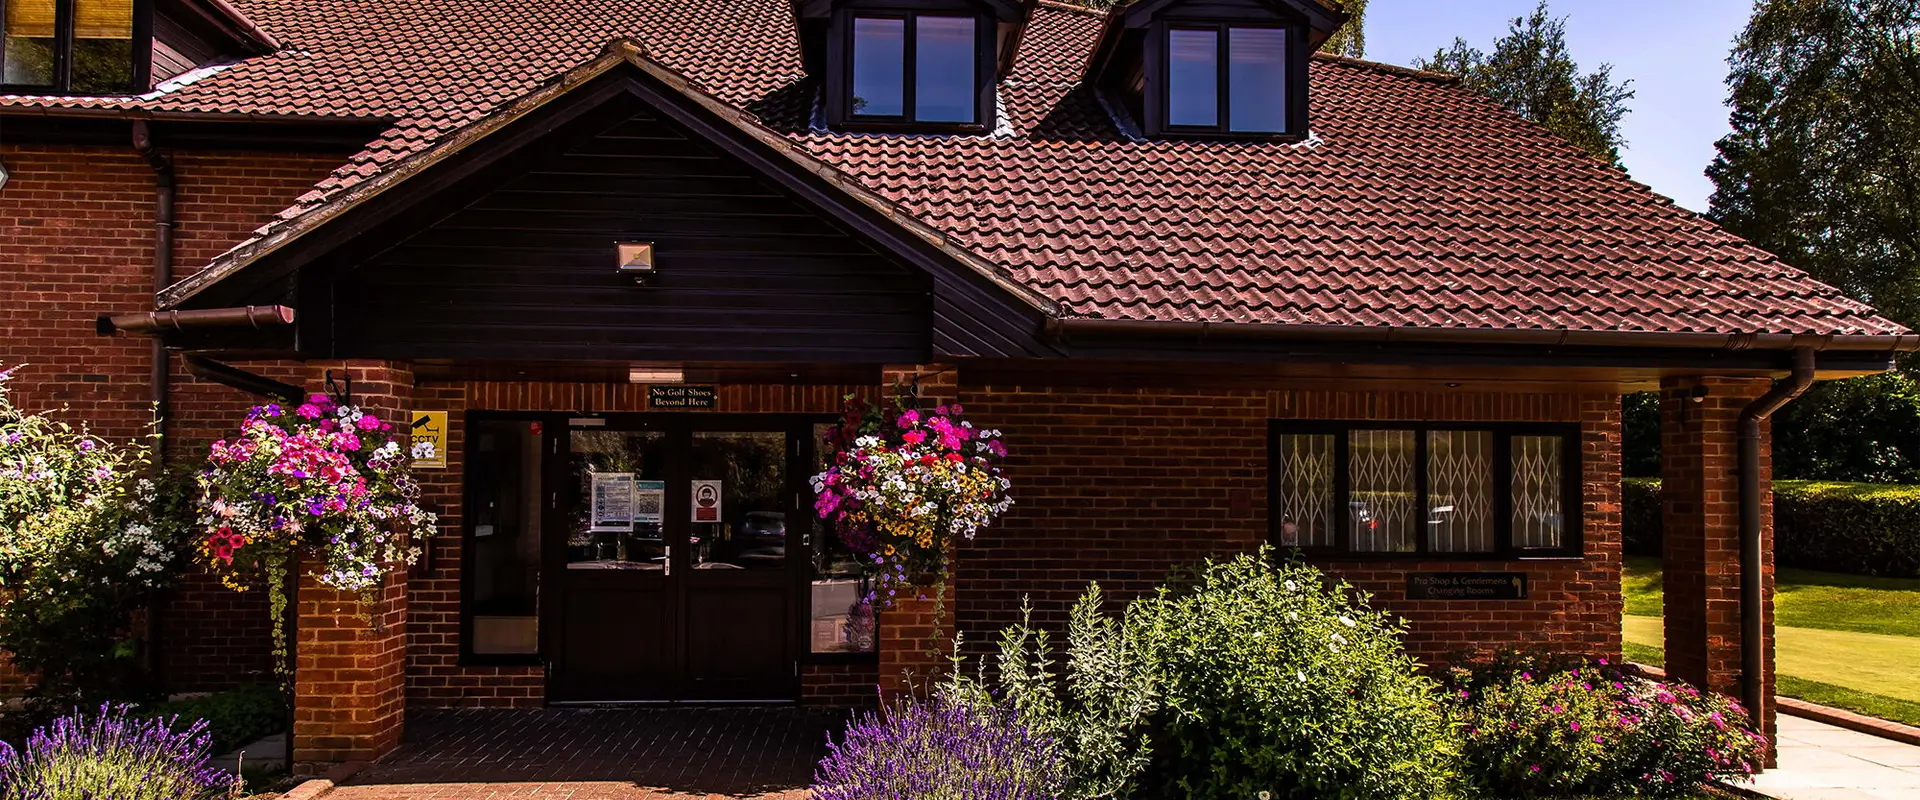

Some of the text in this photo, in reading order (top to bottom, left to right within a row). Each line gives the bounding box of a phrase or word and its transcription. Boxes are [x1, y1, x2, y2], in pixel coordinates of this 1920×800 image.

[652, 388, 711, 396] No Golf Shoes
[655, 398, 709, 406] Beyond Here
[411, 435, 439, 443] CCTV
[1414, 576, 1428, 585] Pro
[1430, 576, 1451, 586] Shop
[1452, 577, 1459, 585] &
[1427, 586, 1495, 596] Changing Rooms
